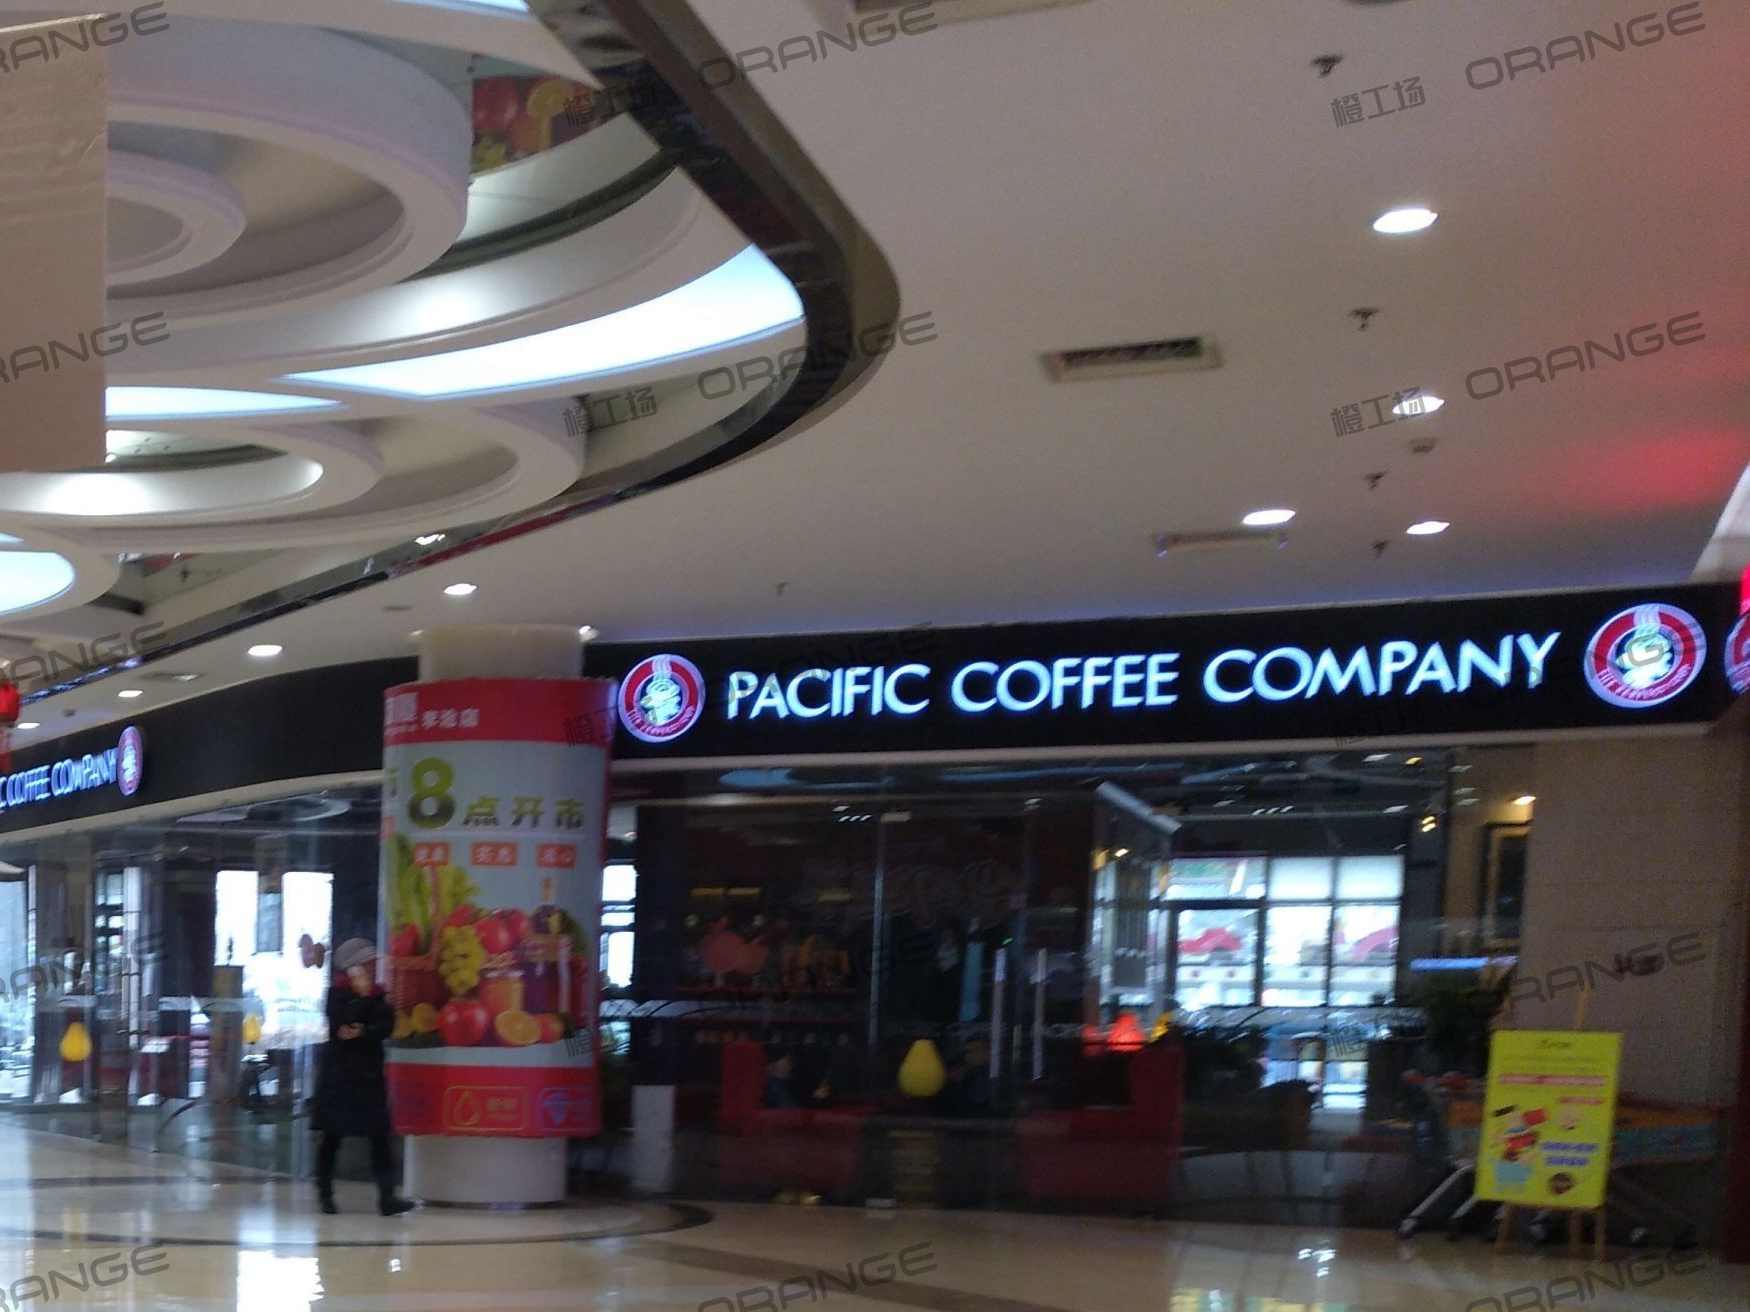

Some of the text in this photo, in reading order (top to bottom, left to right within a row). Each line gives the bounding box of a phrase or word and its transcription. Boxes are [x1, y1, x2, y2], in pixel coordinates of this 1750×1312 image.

[726, 662, 930, 721] PACIFIC
[950, 652, 1181, 714] COFFEE
[1203, 631, 1562, 704] COMPANY
[50, 747, 118, 797] COMPANY
[407, 757, 586, 829] 8点开市
